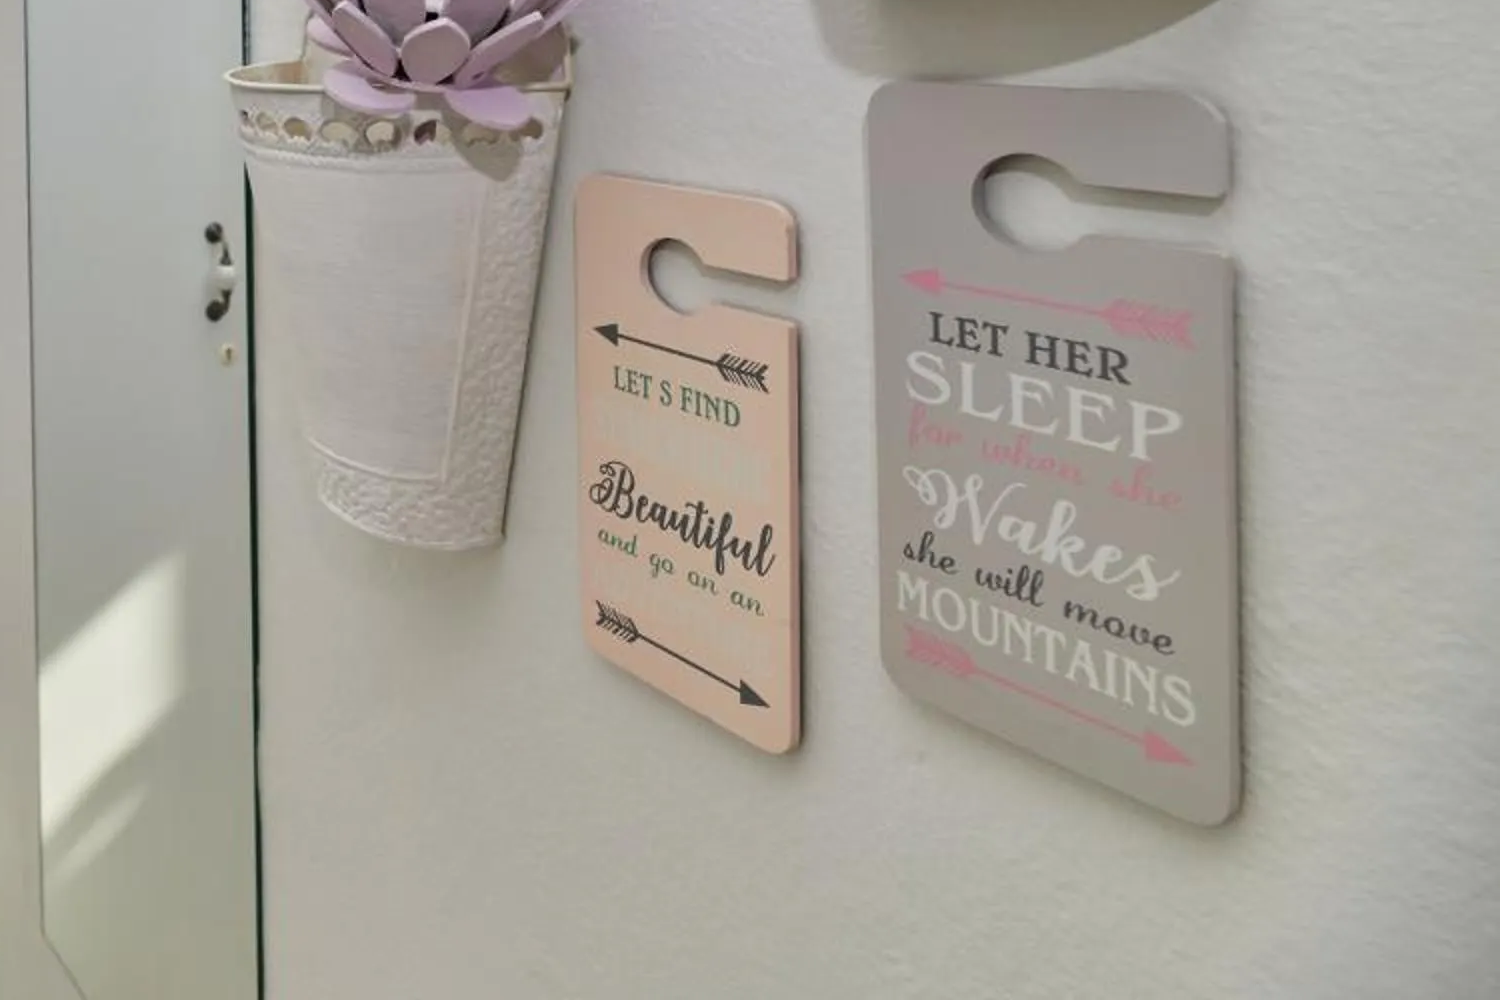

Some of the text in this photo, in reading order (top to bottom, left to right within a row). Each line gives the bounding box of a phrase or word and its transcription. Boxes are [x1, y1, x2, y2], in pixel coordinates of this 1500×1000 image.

[928, 311, 1132, 385] LET HER
[680, 385, 741, 427] FIND
[905, 350, 1184, 462] SLEEP
[589, 460, 776, 577] Beautiful
[597, 528, 638, 558] and
[649, 553, 674, 578] go
[730, 590, 765, 617] an
[902, 465, 1182, 601] Wakes
[896, 569, 1196, 727] MOUNTAINS
[903, 531, 1176, 655] she will move
